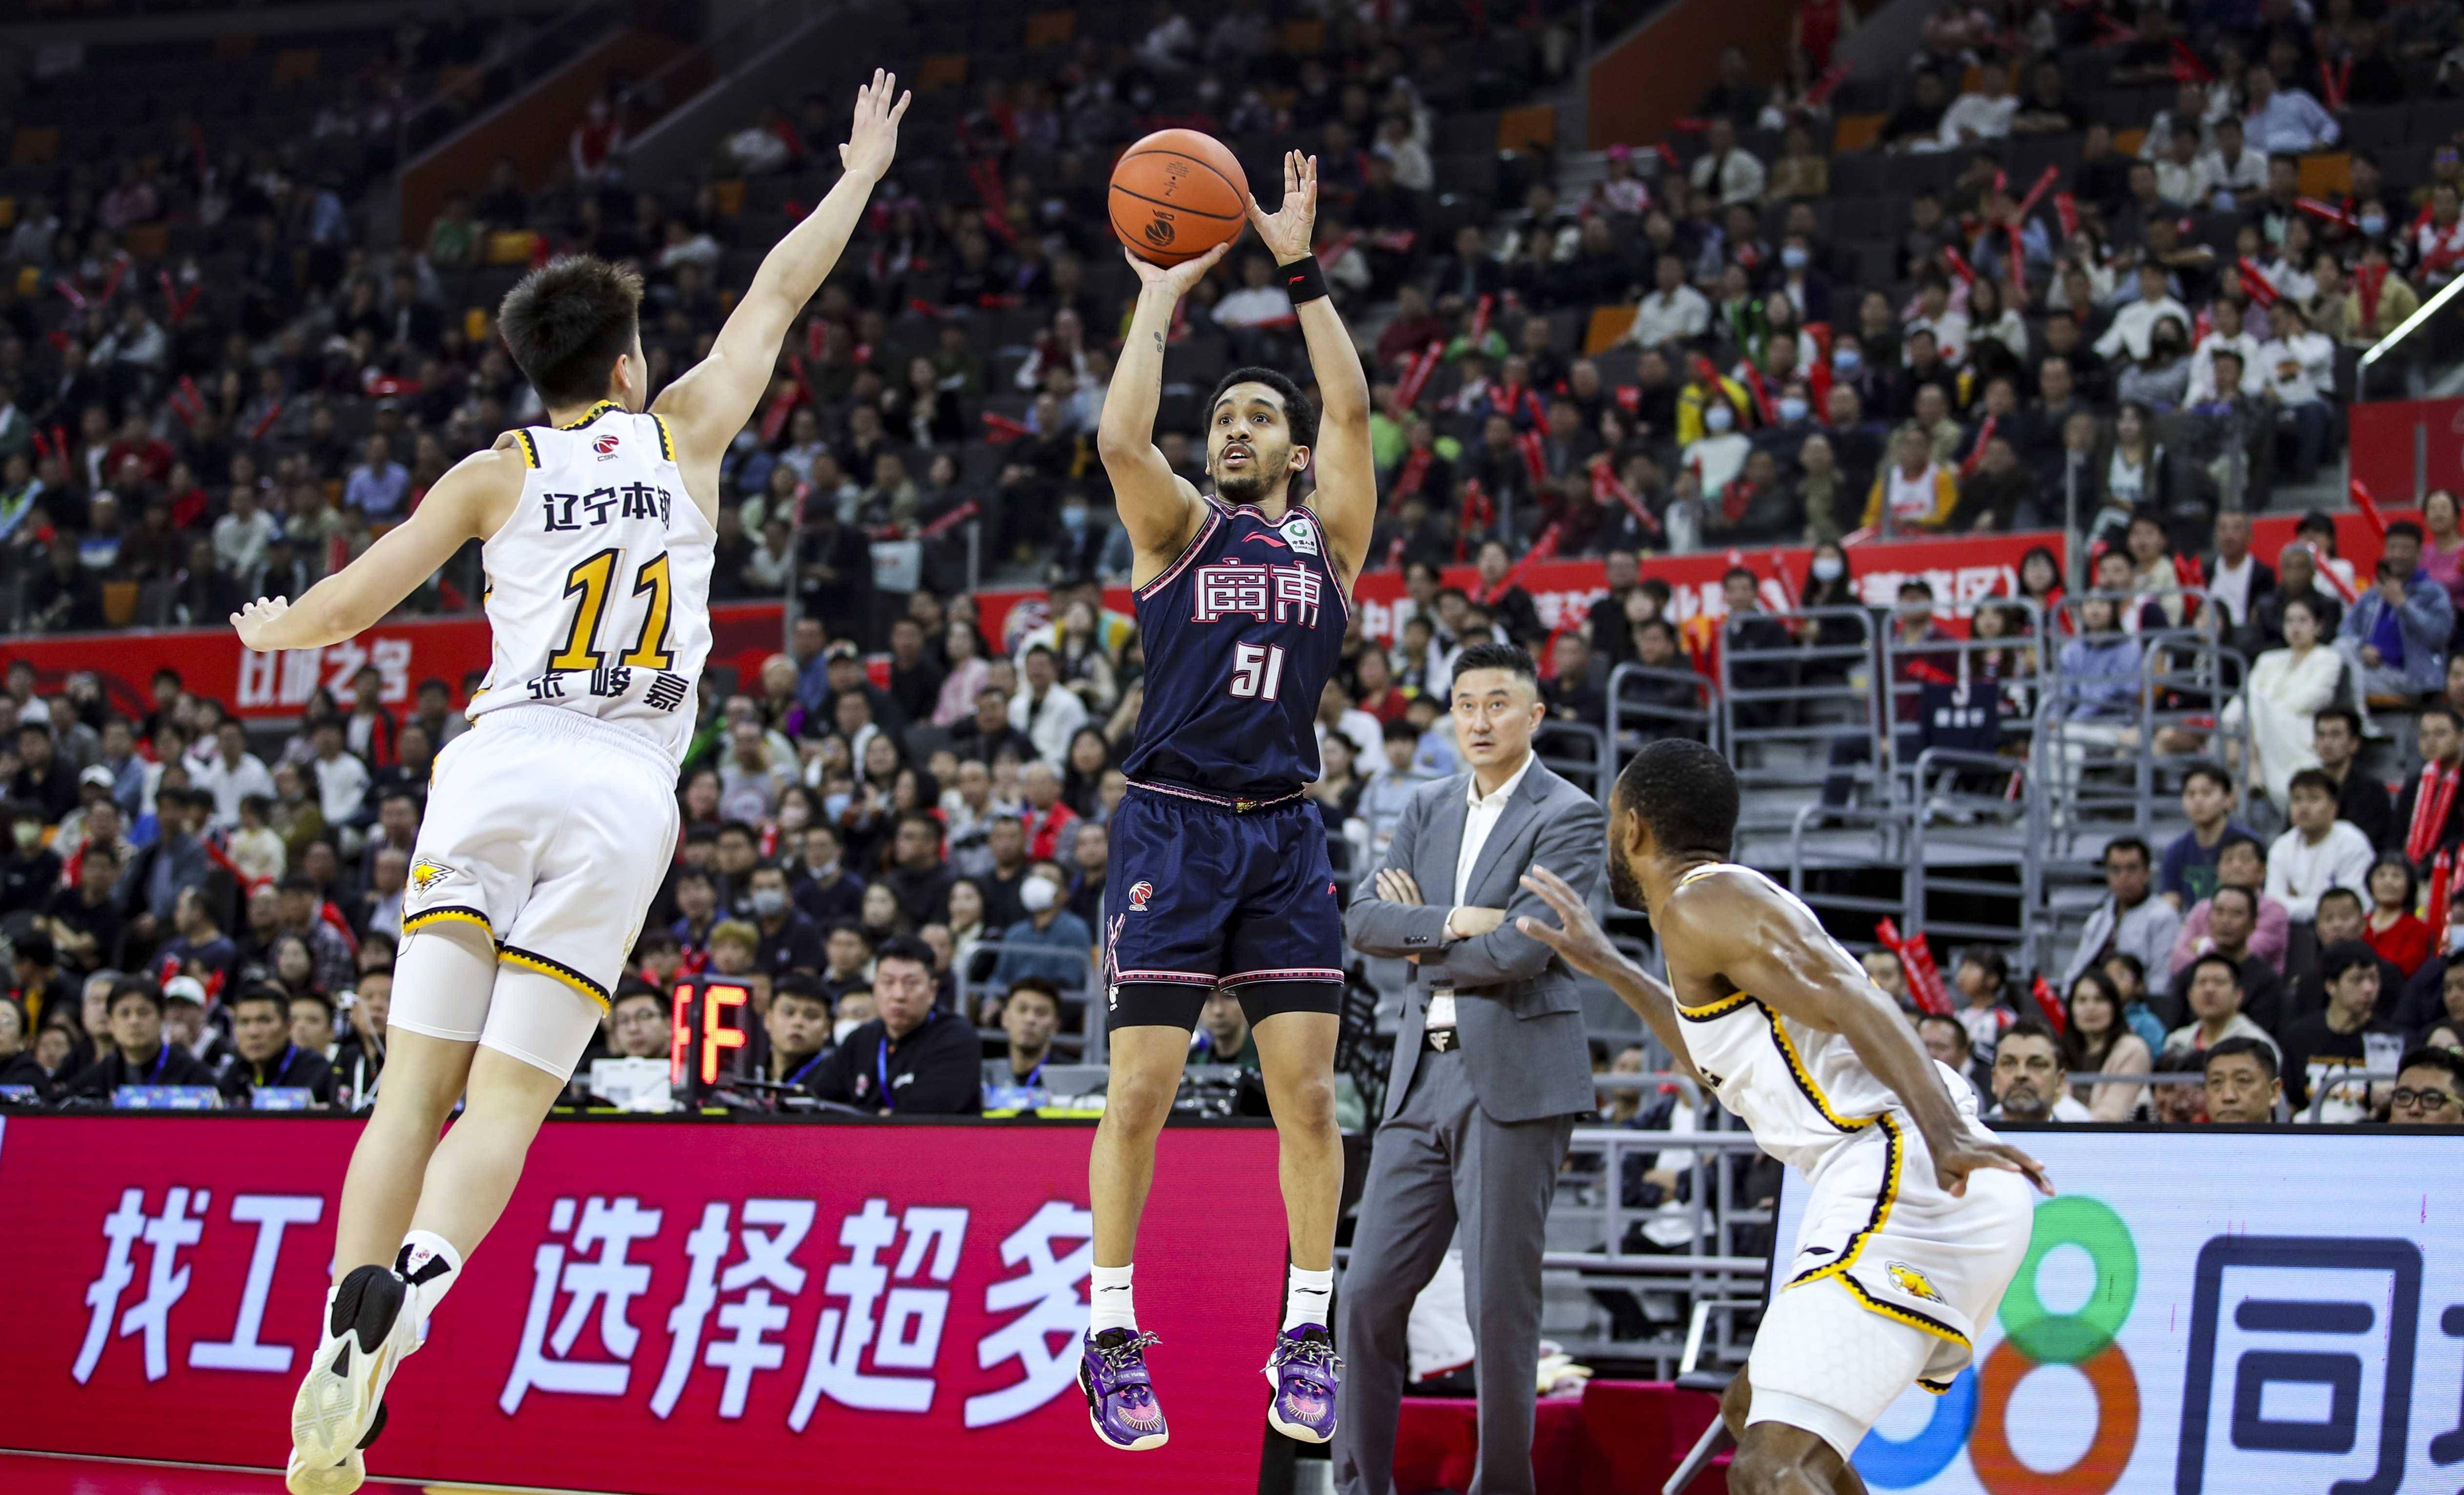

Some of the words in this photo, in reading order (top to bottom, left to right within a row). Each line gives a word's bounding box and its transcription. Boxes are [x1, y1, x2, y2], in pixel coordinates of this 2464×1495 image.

[597, 454, 618, 462] CBA
[546, 548, 682, 675] 11
[1229, 641, 1286, 702] 51
[700, 984, 748, 1085] F
[72, 1186, 431, 1386] 找工
